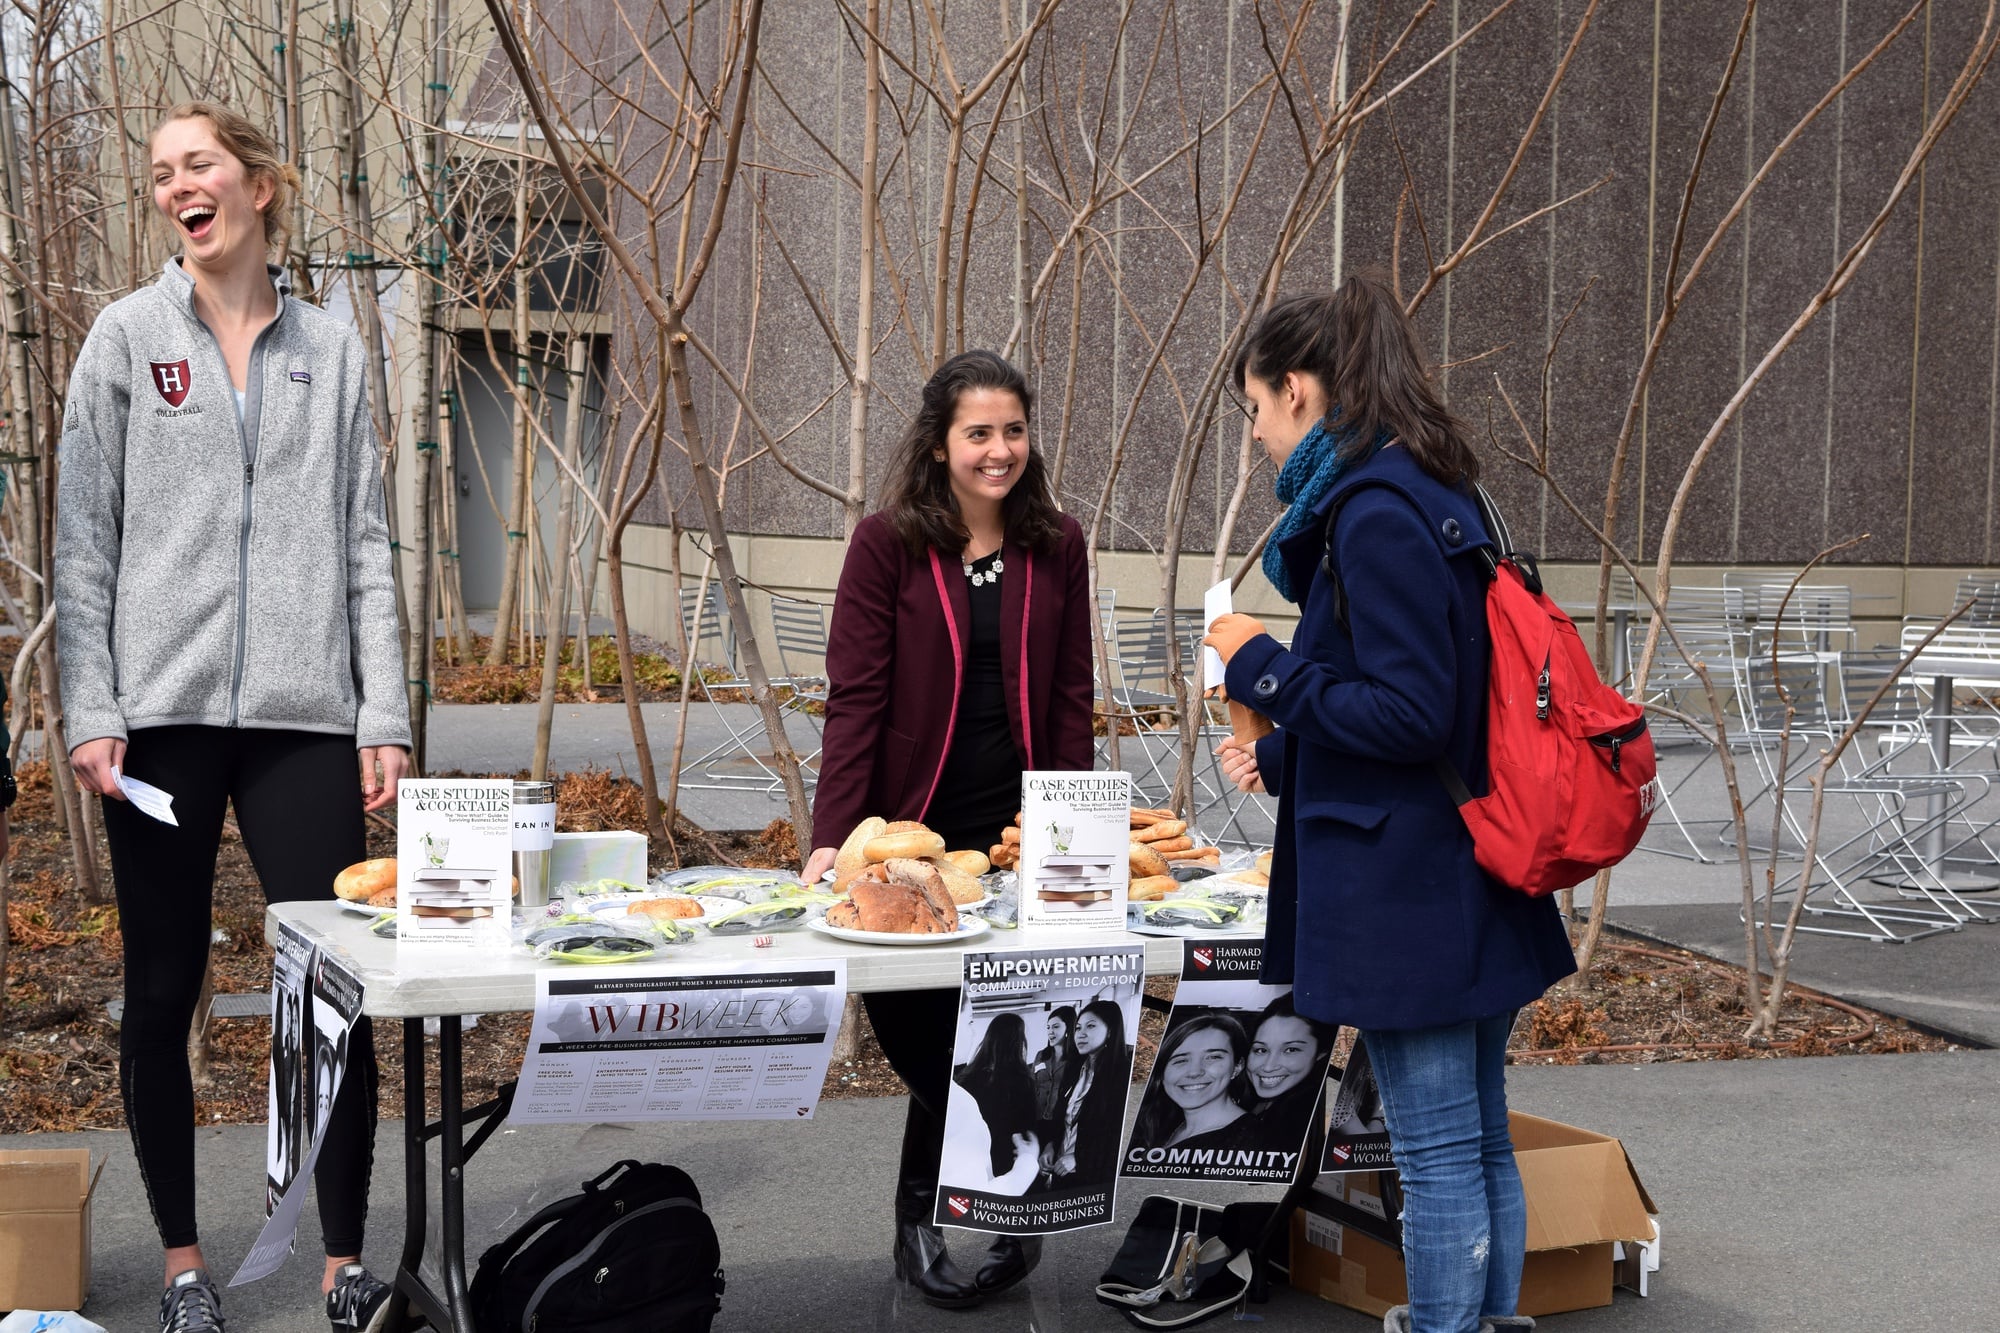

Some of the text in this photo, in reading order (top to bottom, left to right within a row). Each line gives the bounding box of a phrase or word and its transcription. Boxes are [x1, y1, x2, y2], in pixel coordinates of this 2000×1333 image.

[159, 367, 184, 393] H
[156, 406, 203, 418] VOLLEYBALL
[1029, 778, 1128, 790] CASE STUDIES
[402, 788, 510, 800] CASE STUDIES
[1216, 947, 1262, 957] HARVARD
[970, 954, 1140, 979] EMPOWERMENT
[625, 981, 679, 989] UNDERGRADUATE
[969, 974, 1138, 993] COMMUNITY EDUCATION
[649, 1040, 701, 1048] PROGRAMMING
[1128, 1147, 1298, 1168] COMMUNITY
[1353, 1152, 1393, 1164] WOME
[1126, 1164, 1291, 1178] EDUCATION EMPOWERMENT
[973, 1198, 1024, 1213] HARVARD
[1026, 1193, 1106, 1213] UNDERGRADUATE
[972, 1205, 1105, 1226] WOMEN IN BUSINESS
